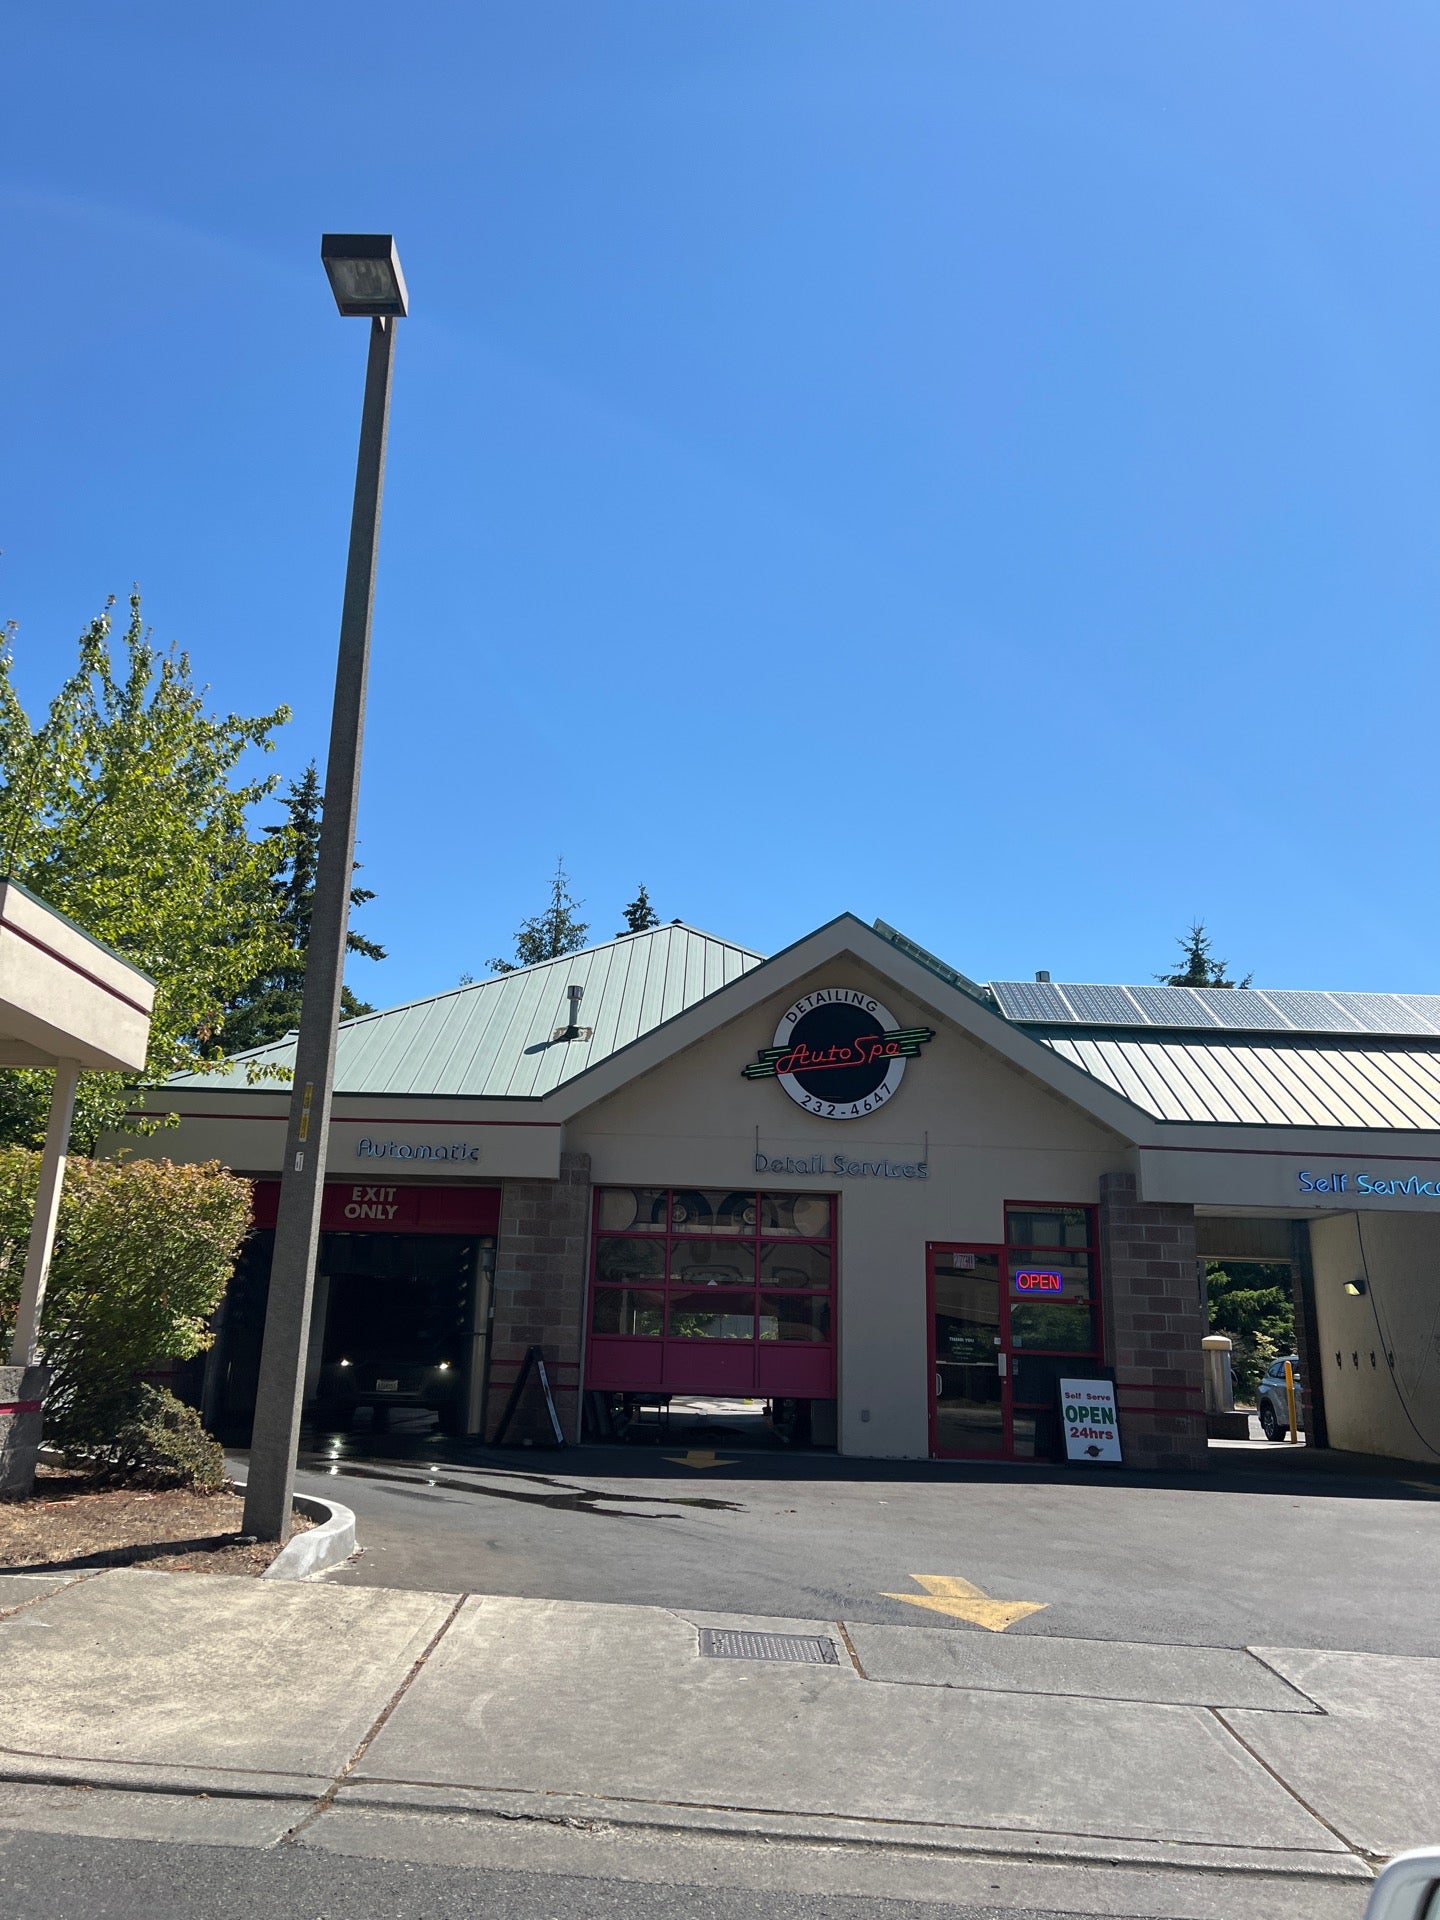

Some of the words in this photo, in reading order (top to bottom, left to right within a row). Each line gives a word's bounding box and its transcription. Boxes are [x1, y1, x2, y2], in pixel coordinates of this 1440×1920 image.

[785, 990, 878, 1024] DETAILING
[800, 1083, 891, 1116] 232-4647
[357, 1138, 480, 1161] Automatic
[755, 1153, 824, 1175] Detail
[833, 1154, 930, 1179] Services
[1299, 1171, 1348, 1193] Self
[352, 1186, 397, 1202] EXIT
[344, 1203, 399, 1220] ONLY
[1018, 1273, 1060, 1290] OPEN
[1087, 1393, 1111, 1401] Serve
[1065, 1405, 1114, 1424] OPEN
[1070, 1426, 1114, 1440] 24hrs
